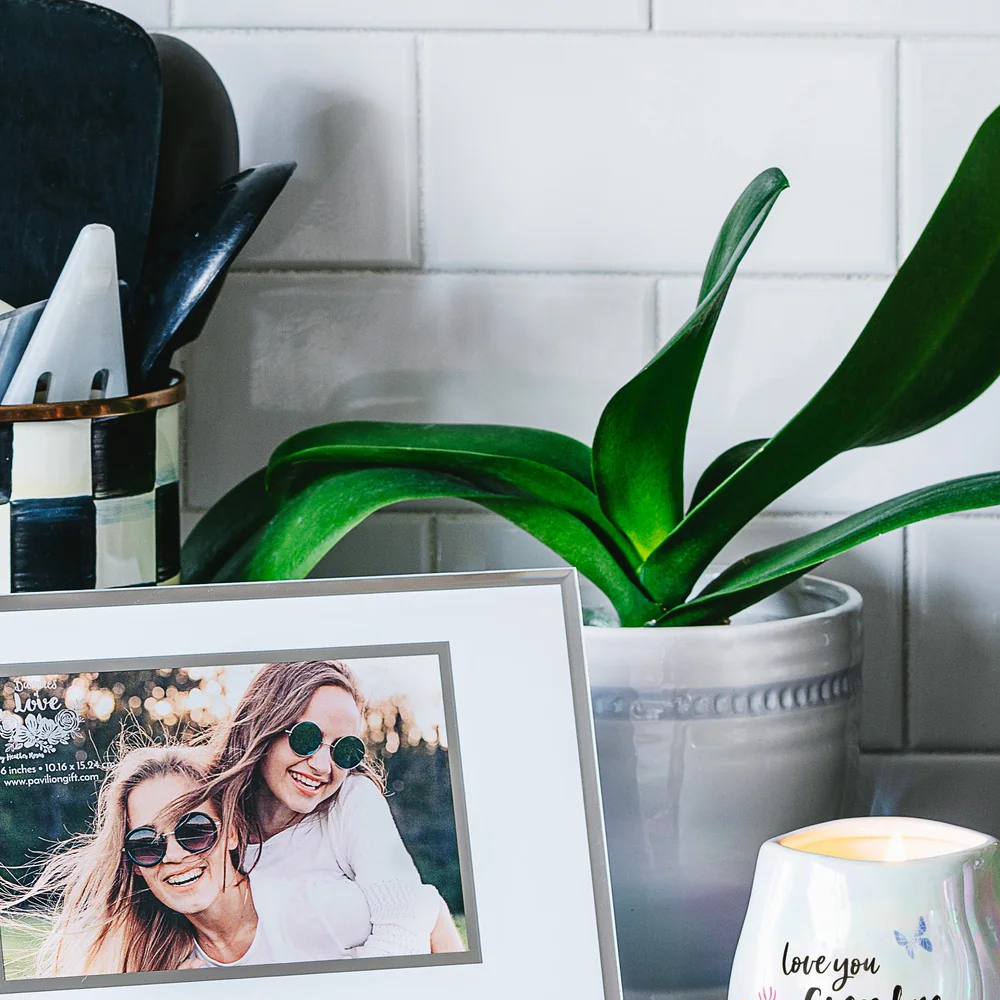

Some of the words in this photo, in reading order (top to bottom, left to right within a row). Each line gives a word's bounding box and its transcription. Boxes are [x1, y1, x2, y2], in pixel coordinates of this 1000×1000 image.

[14, 692, 62, 713] Love
[8, 763, 37, 775] inches
[45, 763, 68, 773] 10.16
[76, 760, 99, 770] 15.24
[3, 772, 99, 787] www.paviliongift.com
[782, 942, 831, 975] love
[832, 958, 880, 991] you
